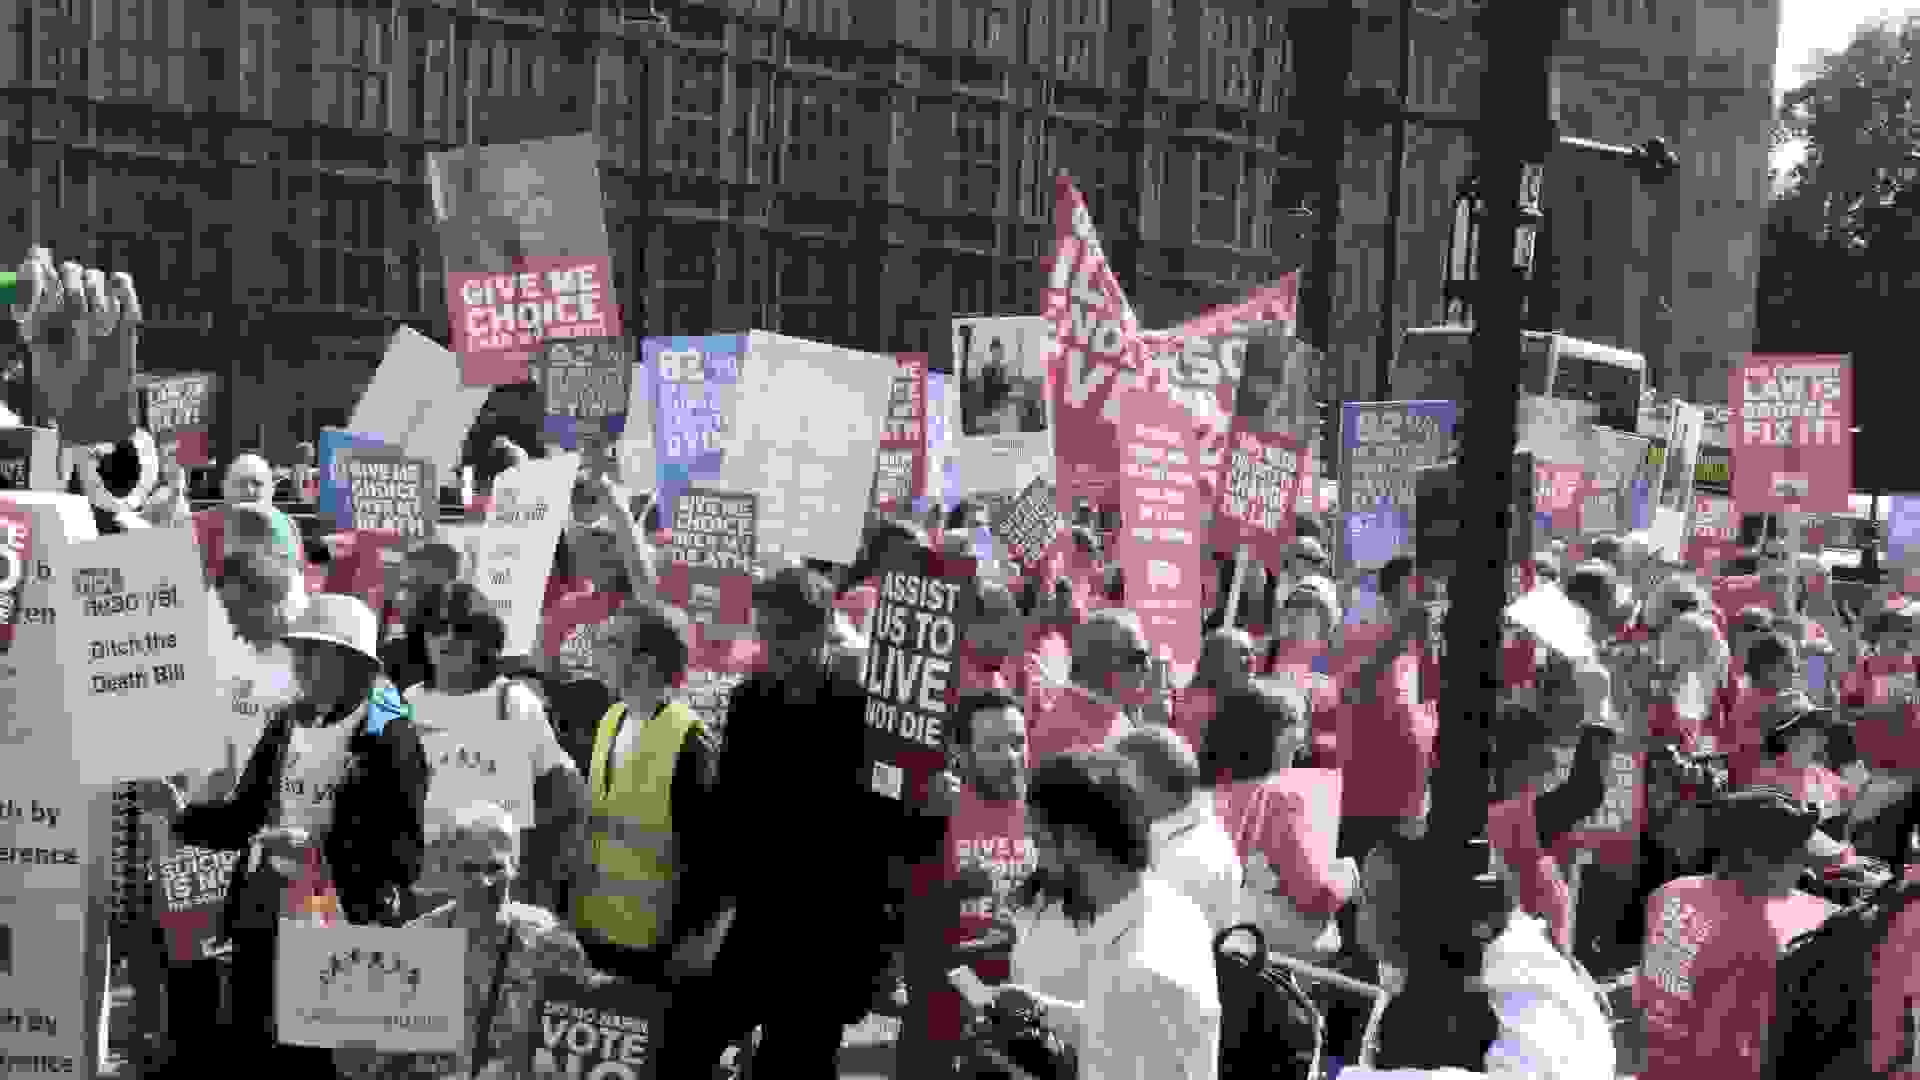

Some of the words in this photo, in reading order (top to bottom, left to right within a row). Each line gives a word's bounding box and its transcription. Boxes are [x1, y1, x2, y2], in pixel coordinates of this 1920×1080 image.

[460, 271, 543, 306] GIVE
[545, 262, 602, 304] ME
[465, 299, 605, 338] CHOICE
[1743, 418, 1794, 446] FIX
[1799, 418, 1841, 446] IT!
[352, 480, 418, 498] CHOICE
[677, 515, 754, 538] CHOICE
[882, 572, 960, 612] ASSIST
[88, 638, 144, 662] Ditch
[144, 632, 177, 655] the
[877, 602, 907, 644] US
[915, 611, 955, 655] TO
[91, 671, 148, 695] Death
[152, 663, 185, 687] Bill
[867, 641, 952, 713] LIVE
[865, 696, 897, 733] NOT
[899, 711, 942, 747] DIE
[32, 799, 61, 830] by
[542, 1016, 649, 1065] VOTE
